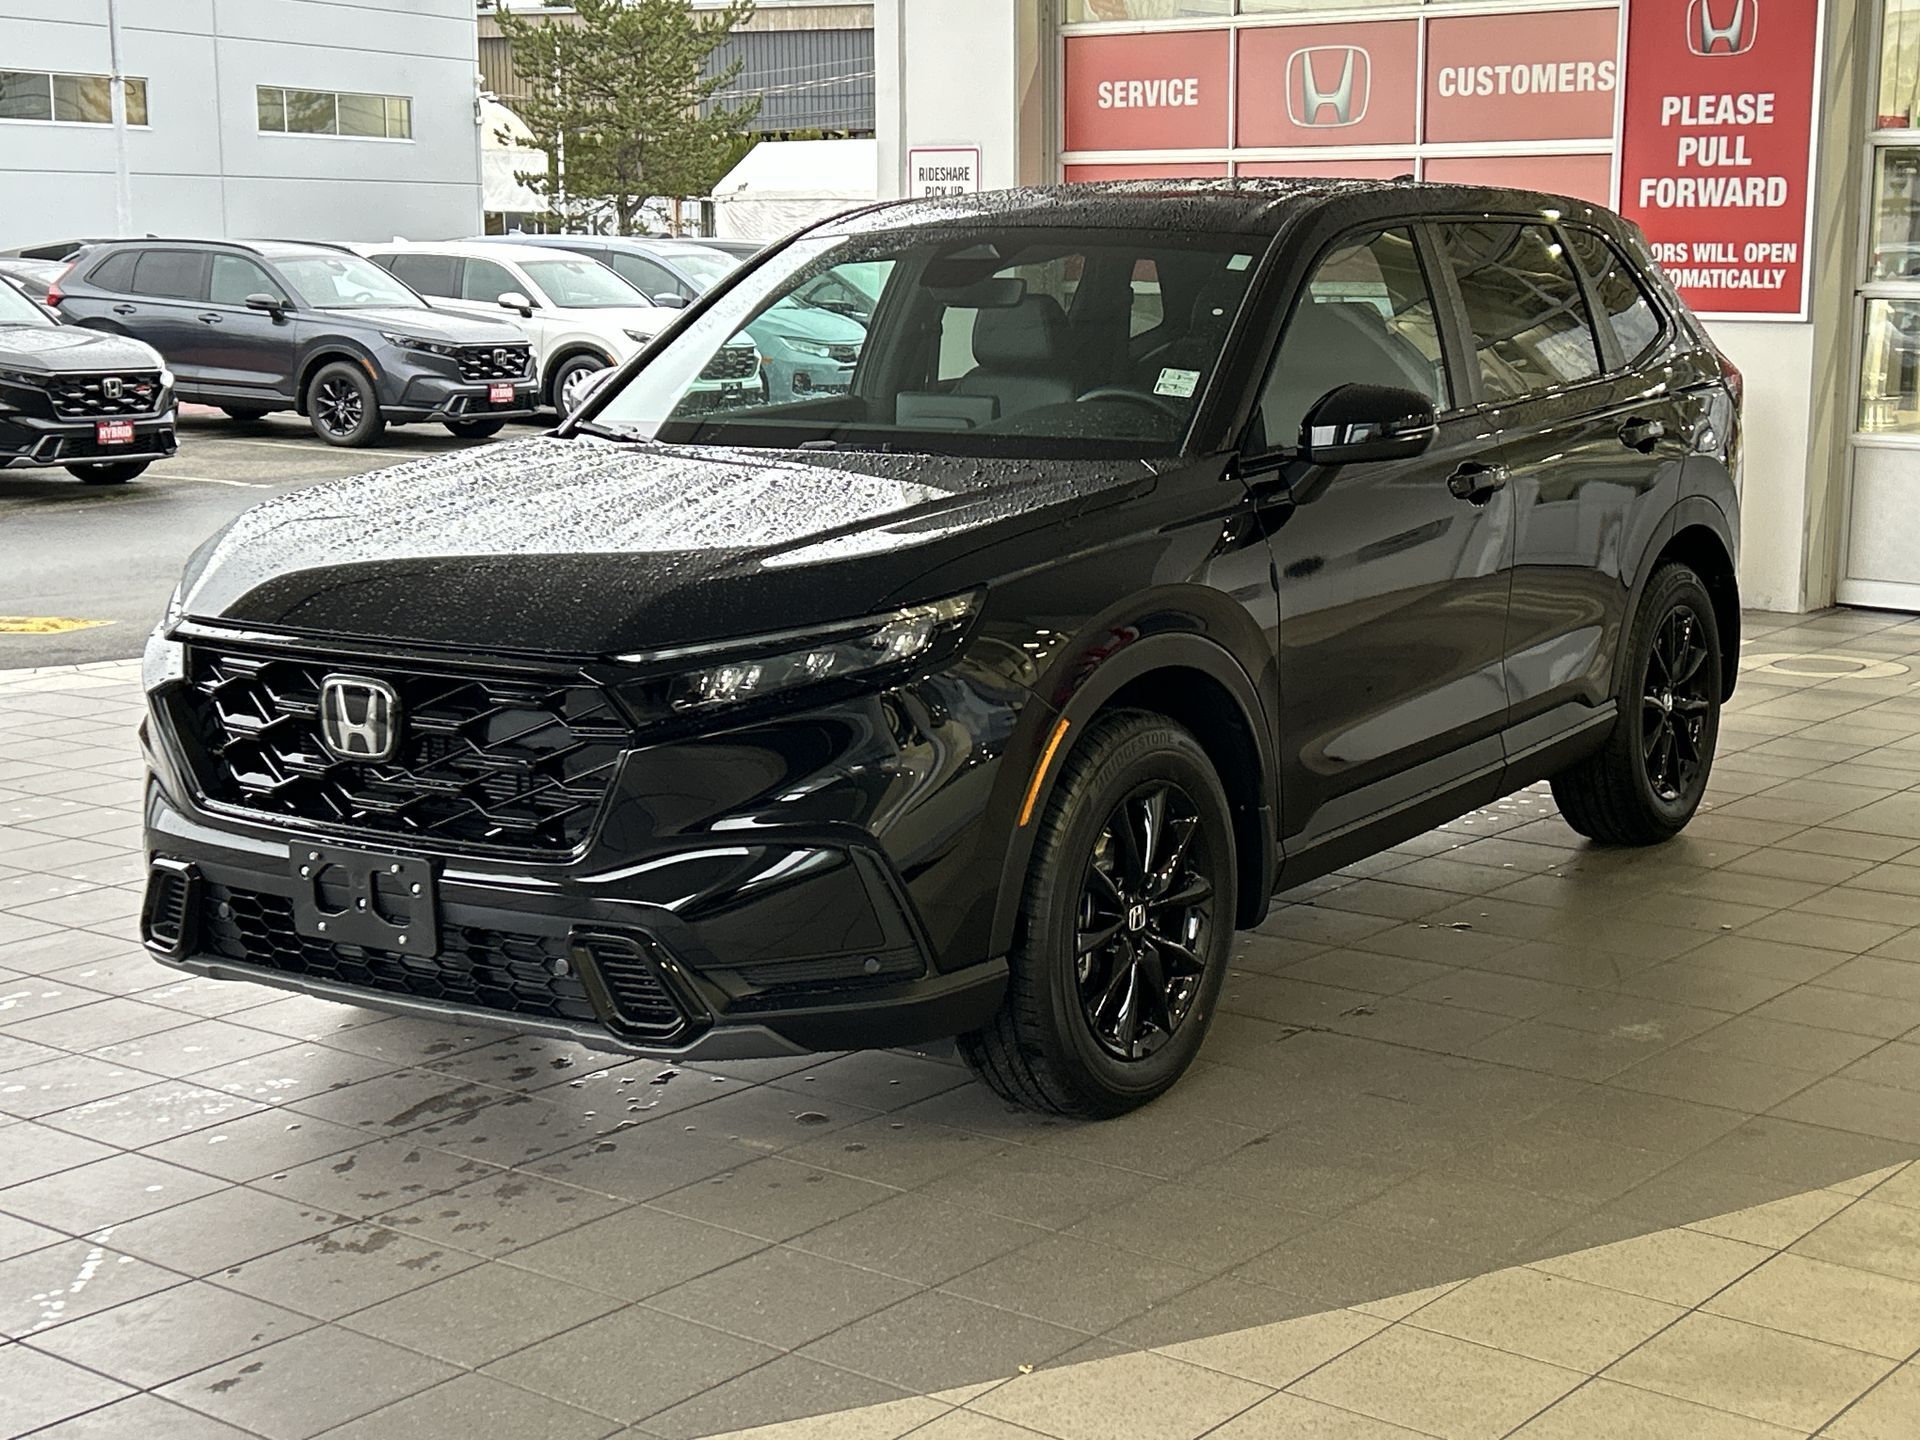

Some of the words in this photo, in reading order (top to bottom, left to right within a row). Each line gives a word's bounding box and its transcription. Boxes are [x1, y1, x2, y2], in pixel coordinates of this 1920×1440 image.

[1438, 60, 1616, 97] CUSTOMERS
[1098, 78, 1199, 108] SERVICE
[1661, 93, 1775, 126] PLEASE
[1677, 135, 1752, 167] PULL
[918, 166, 970, 181] RIDESHARE
[925, 185, 947, 199] PICK
[950, 185, 964, 197] UP
[1639, 176, 1788, 208] FORWARD
[1650, 242, 1689, 263] ORS
[1692, 242, 1739, 263] WILL
[1743, 242, 1798, 263] OPEN
[1663, 268, 1787, 290] OMATICALLY
[99, 426, 132, 439] HYBRID
